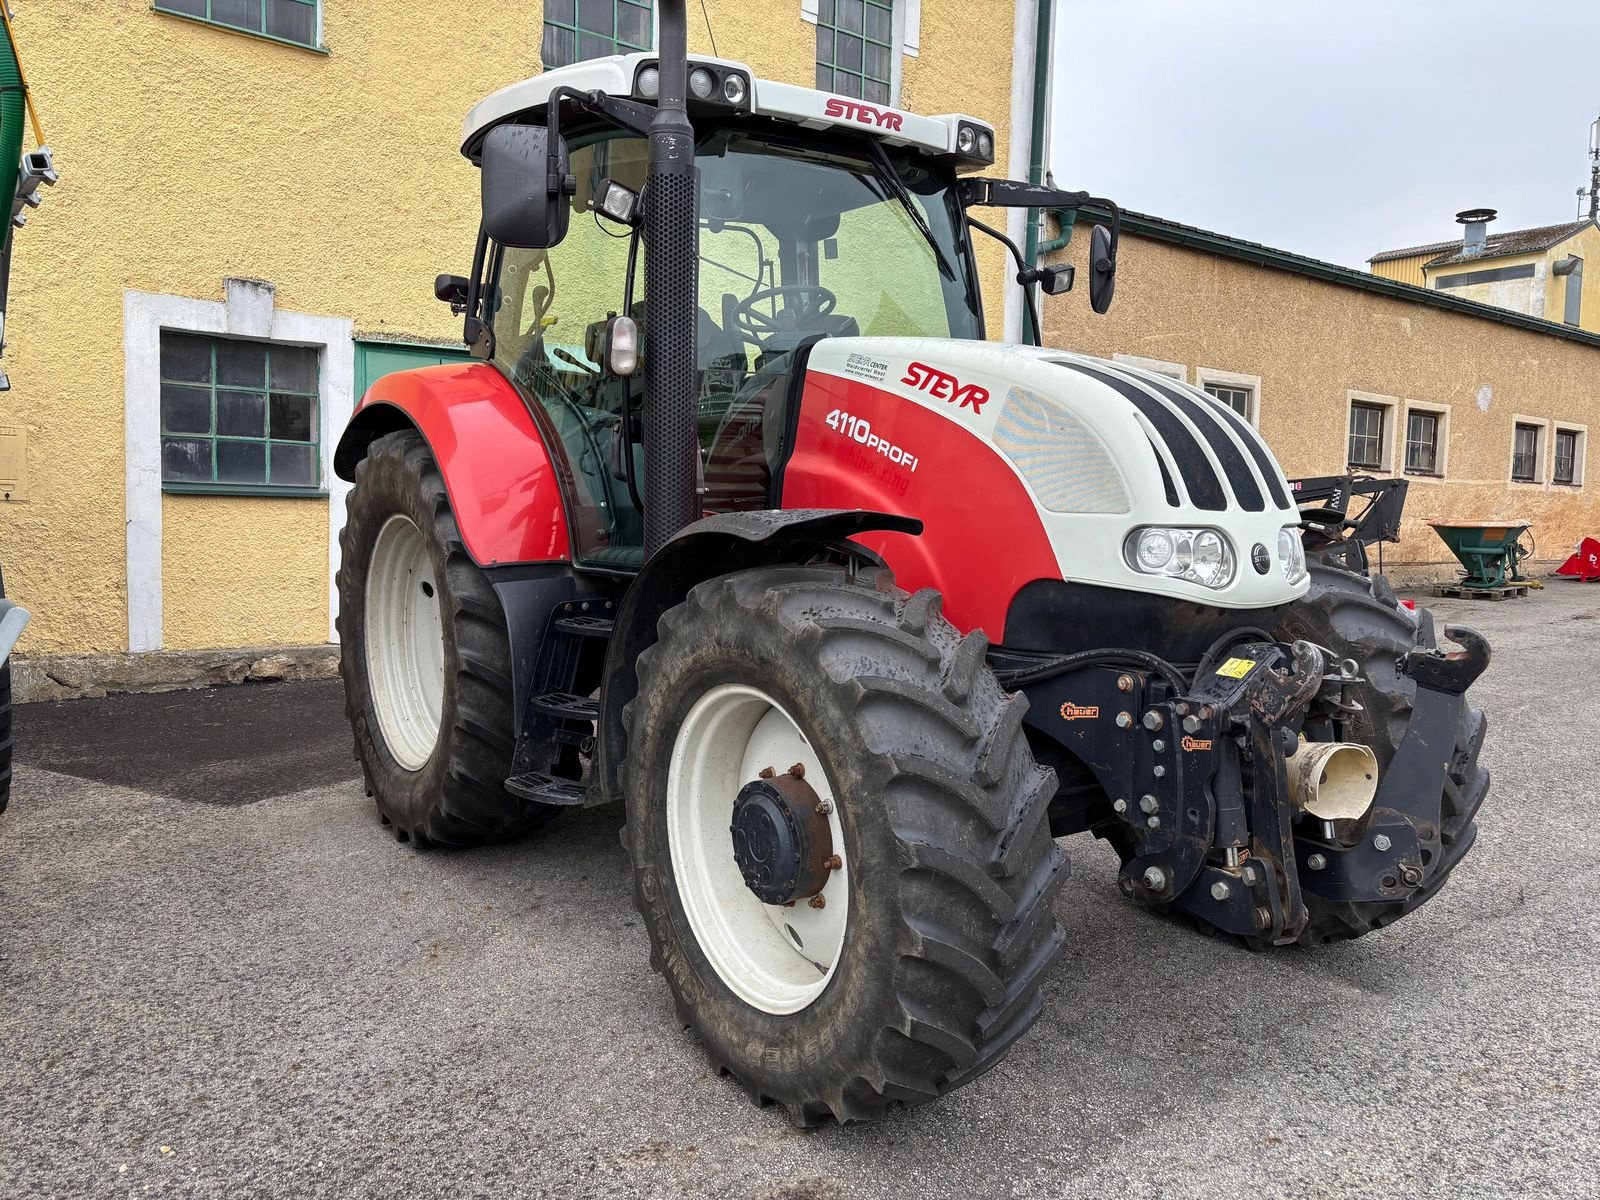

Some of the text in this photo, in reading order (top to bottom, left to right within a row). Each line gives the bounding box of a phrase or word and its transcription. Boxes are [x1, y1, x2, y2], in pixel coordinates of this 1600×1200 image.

[825, 98, 903, 131] STEYR
[870, 361, 888, 370] CENTER
[900, 361, 990, 415] STEYR
[1064, 705, 1099, 718] hauer
[1184, 738, 1211, 750] hauer
